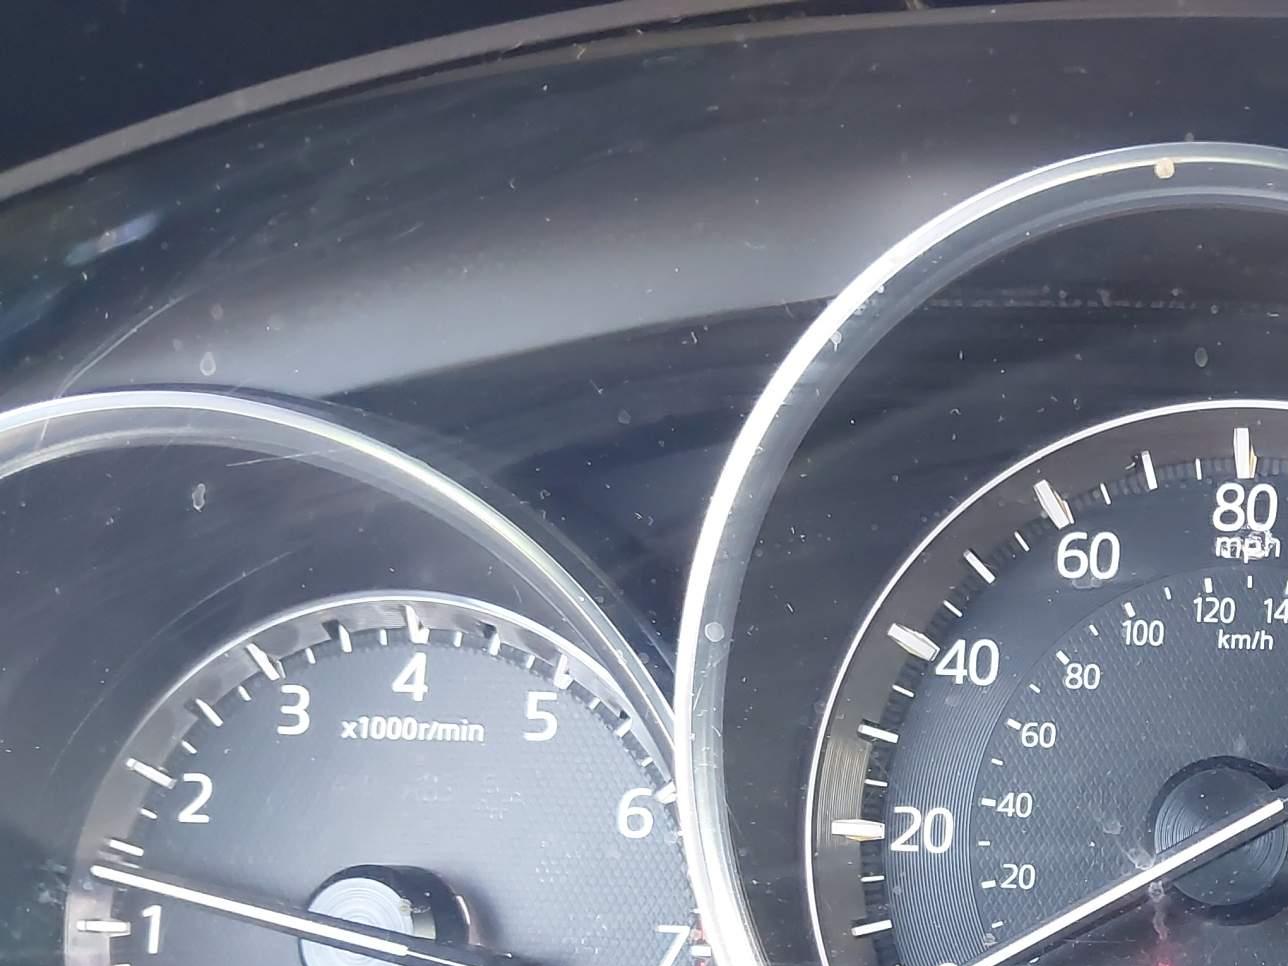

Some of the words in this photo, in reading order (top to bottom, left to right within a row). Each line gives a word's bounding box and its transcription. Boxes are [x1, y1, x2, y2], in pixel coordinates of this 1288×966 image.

[1212, 482, 1278, 535] 80
[1056, 531, 1120, 580] 60
[1215, 532, 1281, 564] mph
[1121, 619, 1165, 647] 100
[1193, 596, 1236, 624] 120
[932, 638, 1000, 686] 40
[1217, 628, 1274, 650] km/h
[391, 652, 429, 702] 4
[1061, 659, 1101, 690] 80
[277, 684, 310, 735] 3
[341, 716, 485, 742] x1000r/min
[523, 691, 558, 742] 5
[1021, 722, 1057, 749] 60
[177, 772, 213, 823] 2
[617, 787, 654, 839] 6
[996, 792, 1033, 818] 40
[890, 802, 957, 857] 20
[999, 863, 1036, 890] 20
[142, 904, 162, 954] 1
